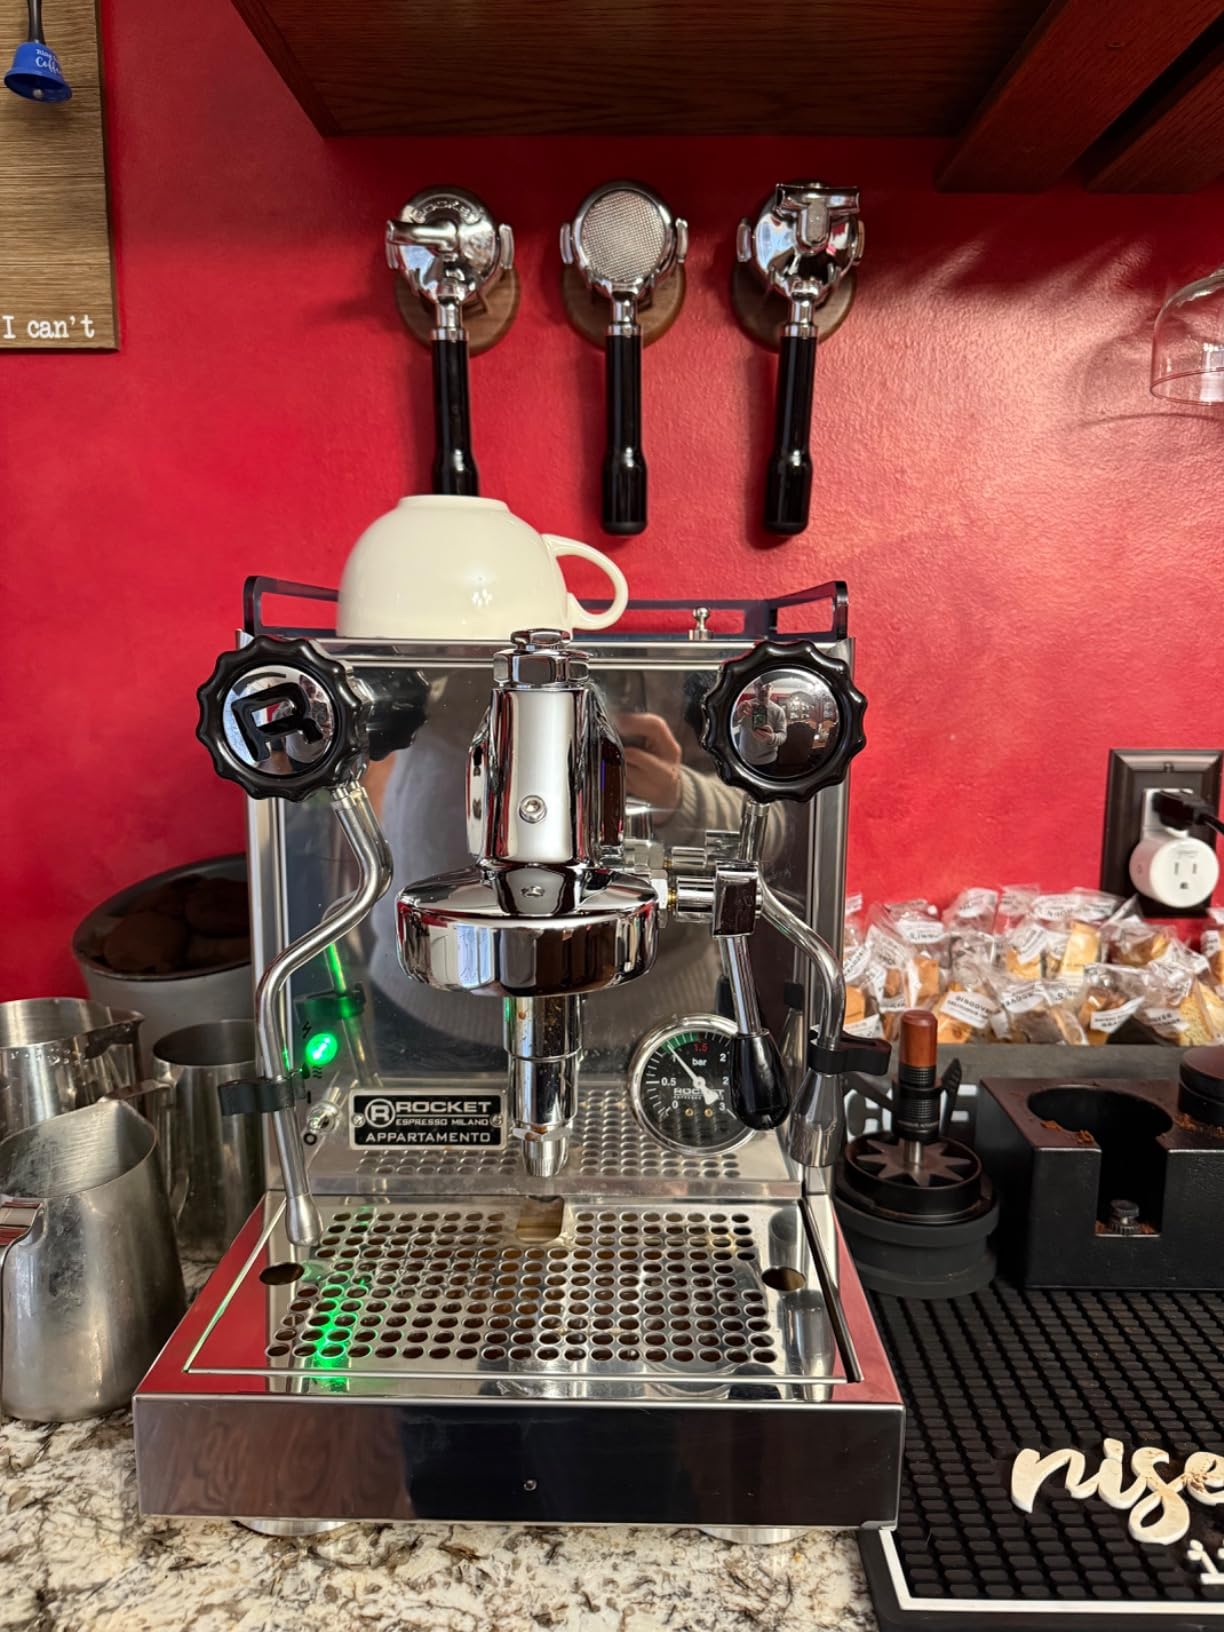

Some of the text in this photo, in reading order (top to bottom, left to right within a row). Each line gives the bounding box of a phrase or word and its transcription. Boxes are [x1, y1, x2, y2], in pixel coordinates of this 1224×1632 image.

[2, 314, 95, 339] I can't
[692, 1057, 708, 1066] bar
[661, 1077, 677, 1086] 0.5
[395, 1100, 492, 1113] ROCKET
[395, 1118, 489, 1127] ESPRESSO MILANO
[365, 1131, 491, 1143] APPARTAMENTO
[1011, 1437, 1224, 1546] rise
